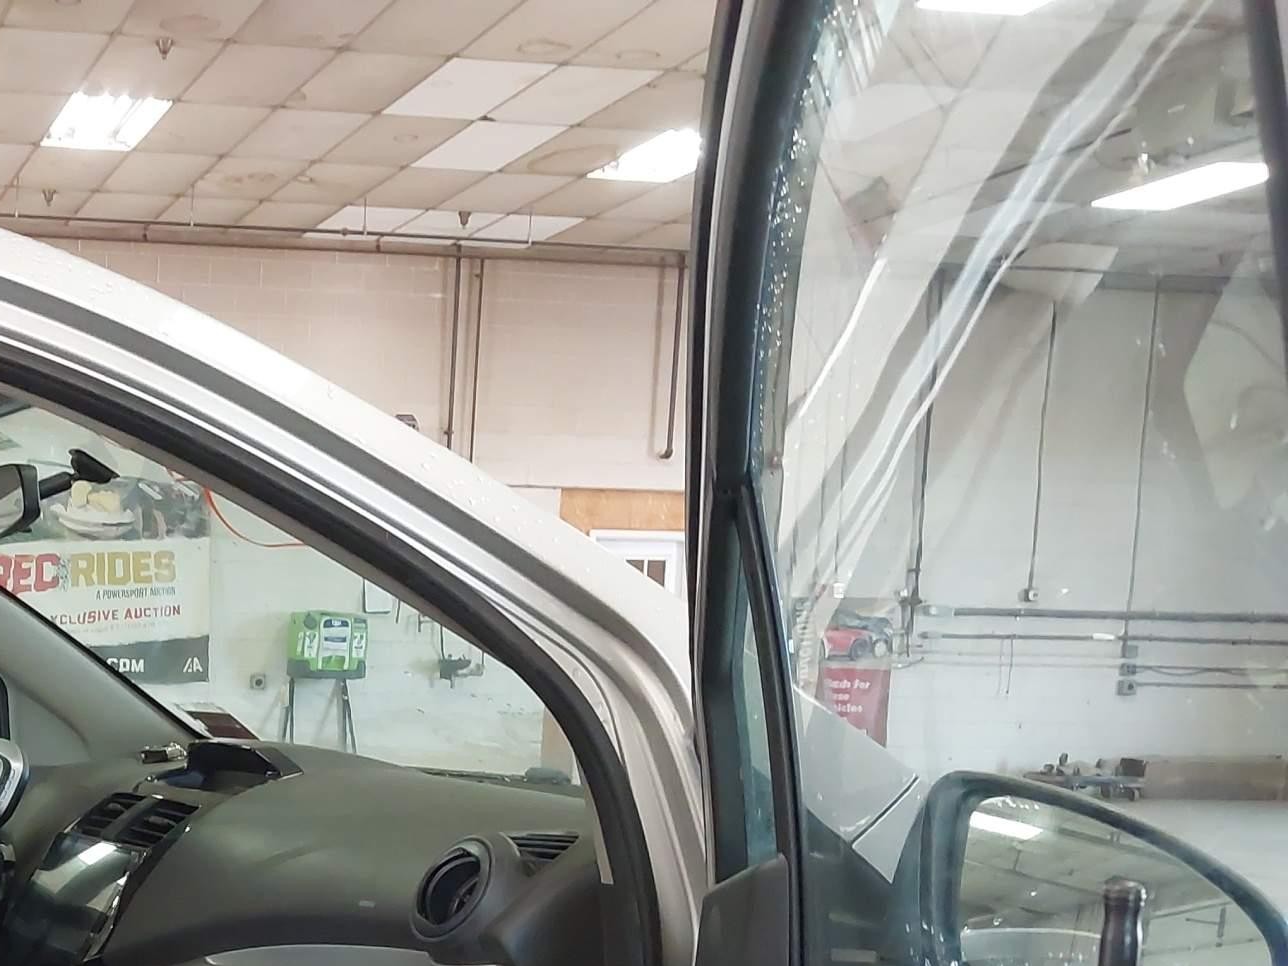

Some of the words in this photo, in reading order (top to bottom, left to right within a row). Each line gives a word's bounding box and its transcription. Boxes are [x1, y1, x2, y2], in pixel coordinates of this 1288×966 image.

[70, 550, 177, 588] RIDES
[95, 590, 101, 601] A
[102, 587, 148, 600] POWERSPORT
[149, 586, 176, 597] AUCTION
[124, 604, 181, 620] AUCTION
